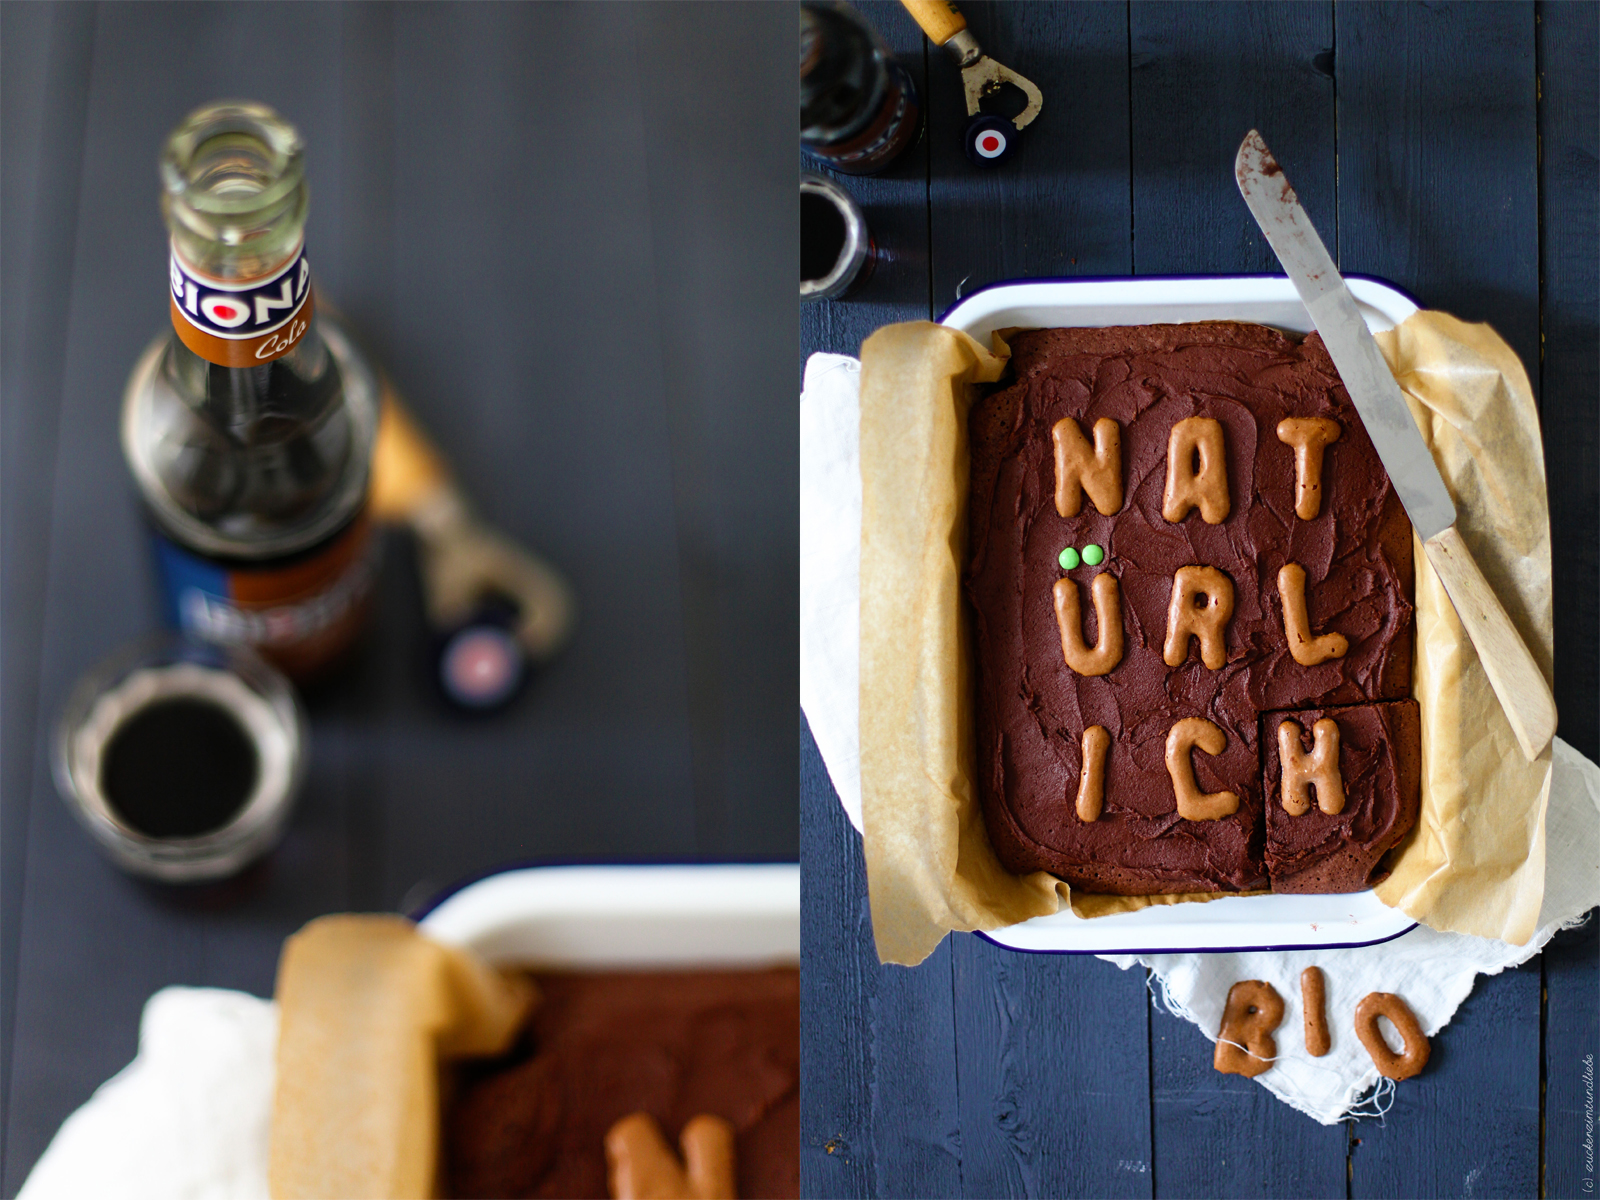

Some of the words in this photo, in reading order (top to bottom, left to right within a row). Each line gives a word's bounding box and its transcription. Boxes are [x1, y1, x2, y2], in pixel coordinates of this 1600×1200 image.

[254, 318, 307, 360] Cola
[1052, 416, 1342, 525] NAT
[1076, 717, 1346, 823] ICH
